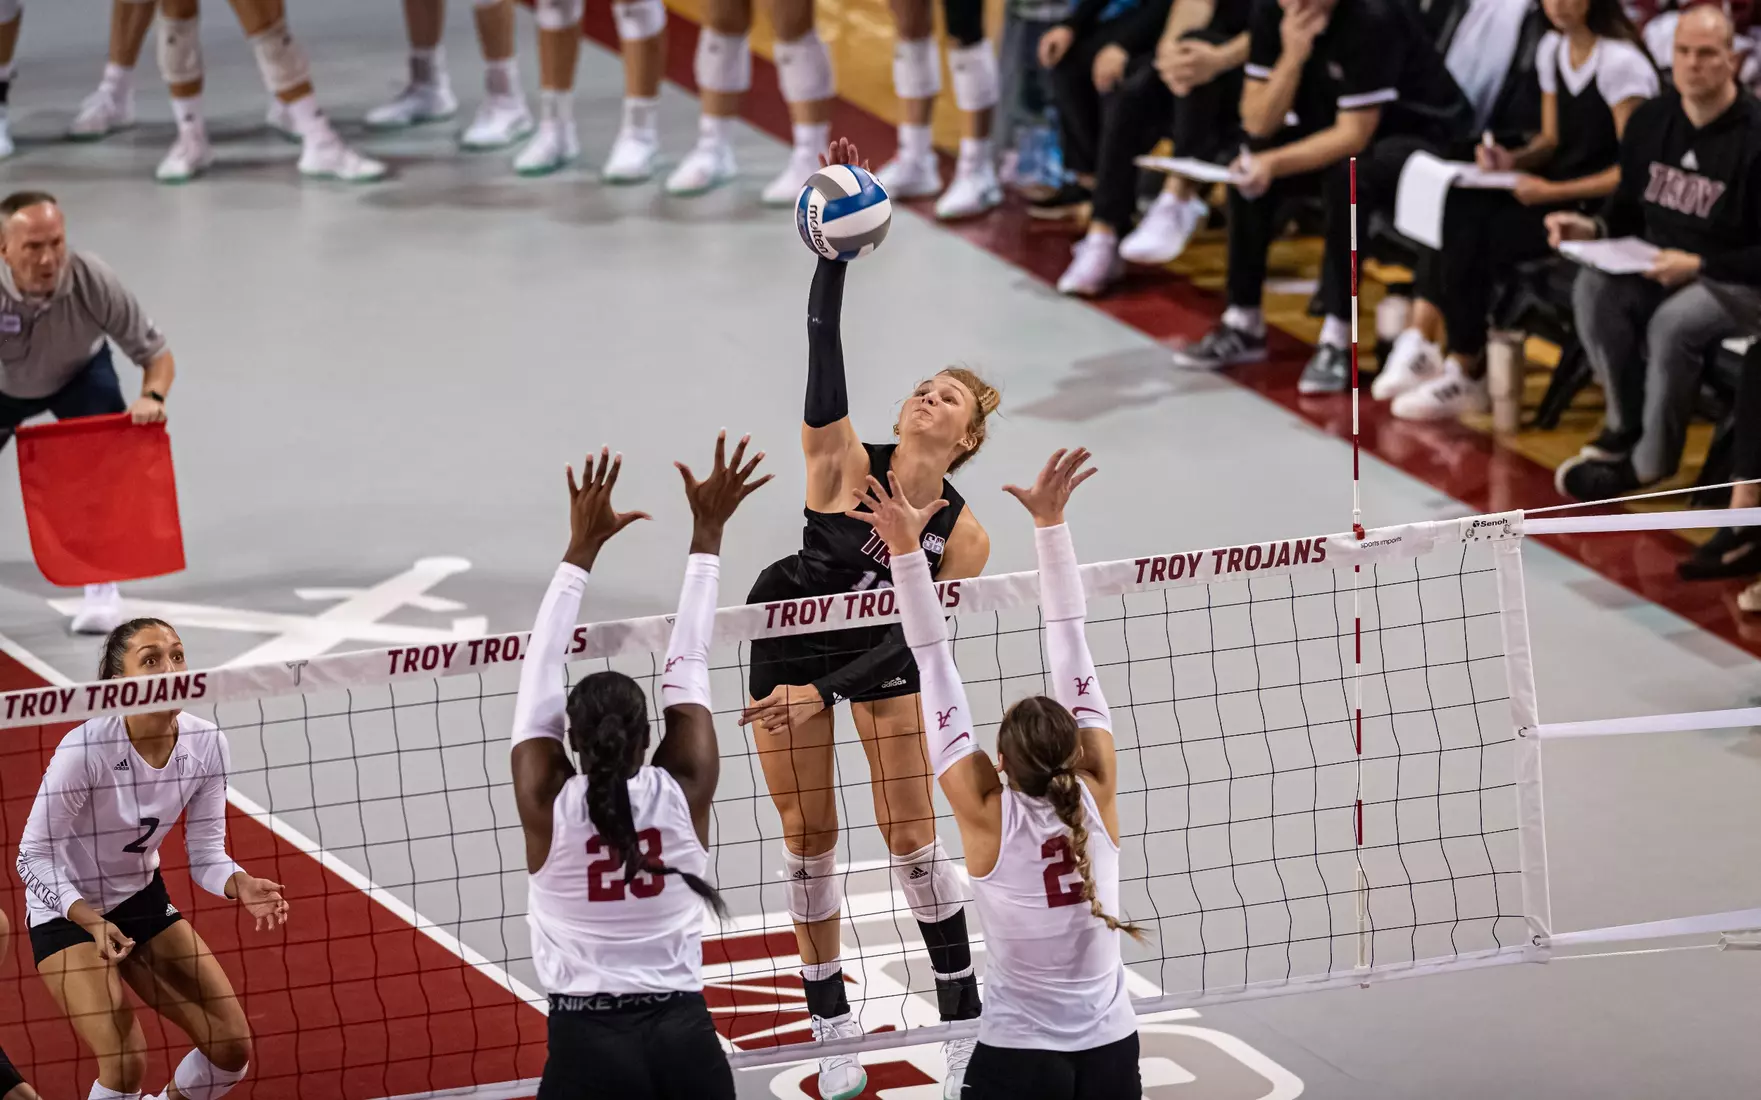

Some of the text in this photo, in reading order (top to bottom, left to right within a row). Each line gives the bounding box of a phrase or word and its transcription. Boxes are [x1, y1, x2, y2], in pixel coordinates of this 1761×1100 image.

[1644, 160, 1727, 219] TROY
[809, 204, 829, 254] molten
[1361, 536, 1402, 549] sports imports
[1481, 518, 1508, 527] Senoh
[1135, 537, 1327, 584] TROY TROJANS
[765, 582, 961, 629] TROY TROS
[388, 627, 587, 675] TROY TROS
[5, 673, 207, 719] TROY TROJANS
[881, 679, 907, 689] adidas
[122, 817, 160, 854] 2
[586, 828, 665, 902] 23
[1041, 834, 1088, 908] 2
[558, 997, 613, 1011] NIKE
